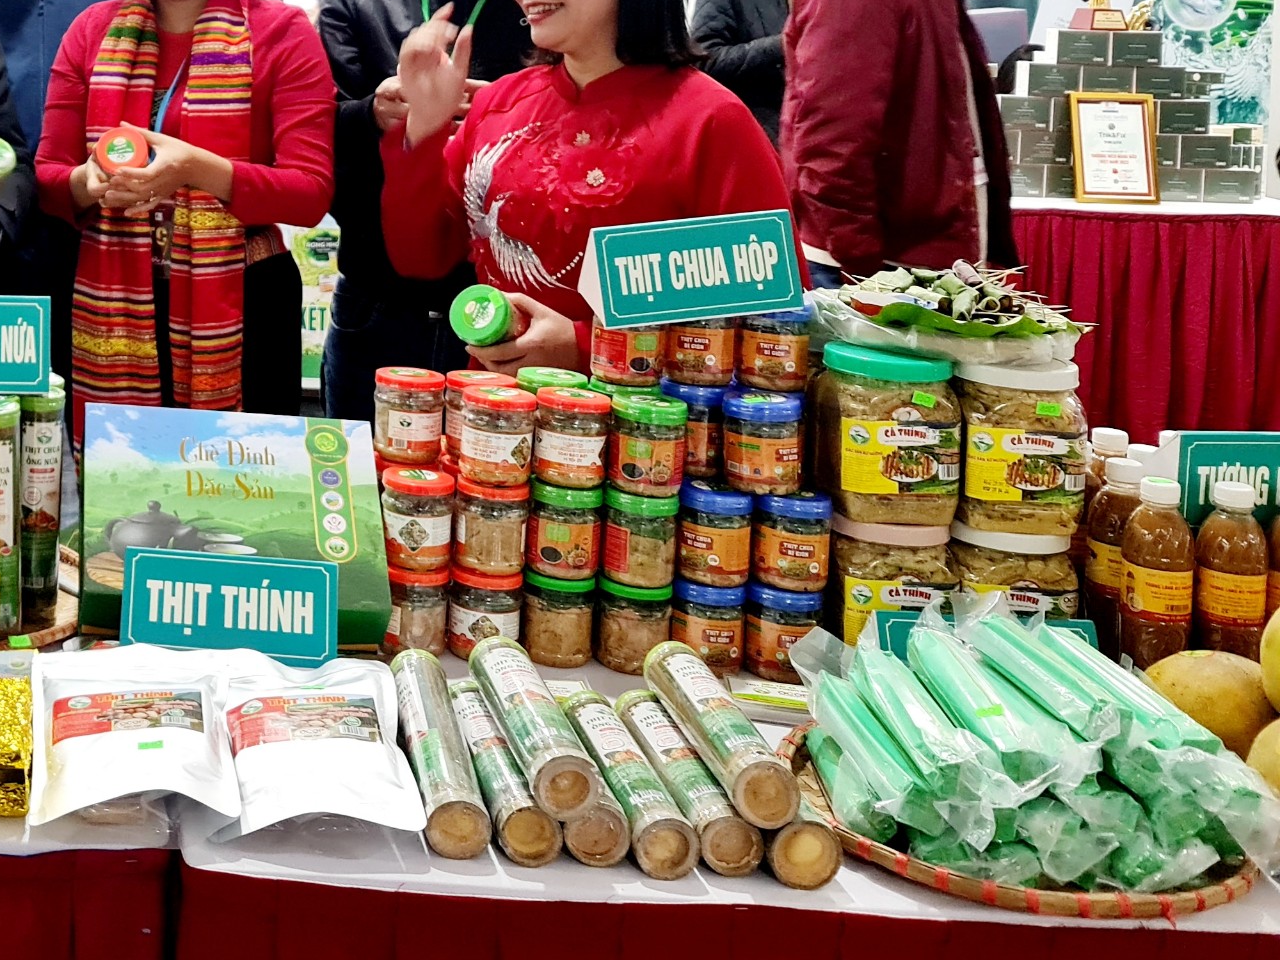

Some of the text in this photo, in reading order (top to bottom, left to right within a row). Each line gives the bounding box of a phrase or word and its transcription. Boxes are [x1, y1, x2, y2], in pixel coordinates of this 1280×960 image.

[614, 233, 779, 302] THỊT CHUA HỘP
[0, 317, 37, 363] NỨA
[179, 435, 219, 464] Chè
[232, 471, 275, 501] Sản
[146, 579, 314, 636] THỊT THÍNH
[902, 587, 932, 601] THÍNH
[96, 690, 173, 704] THỊT THÍNH
[270, 694, 347, 707] THỊT THÍNH
